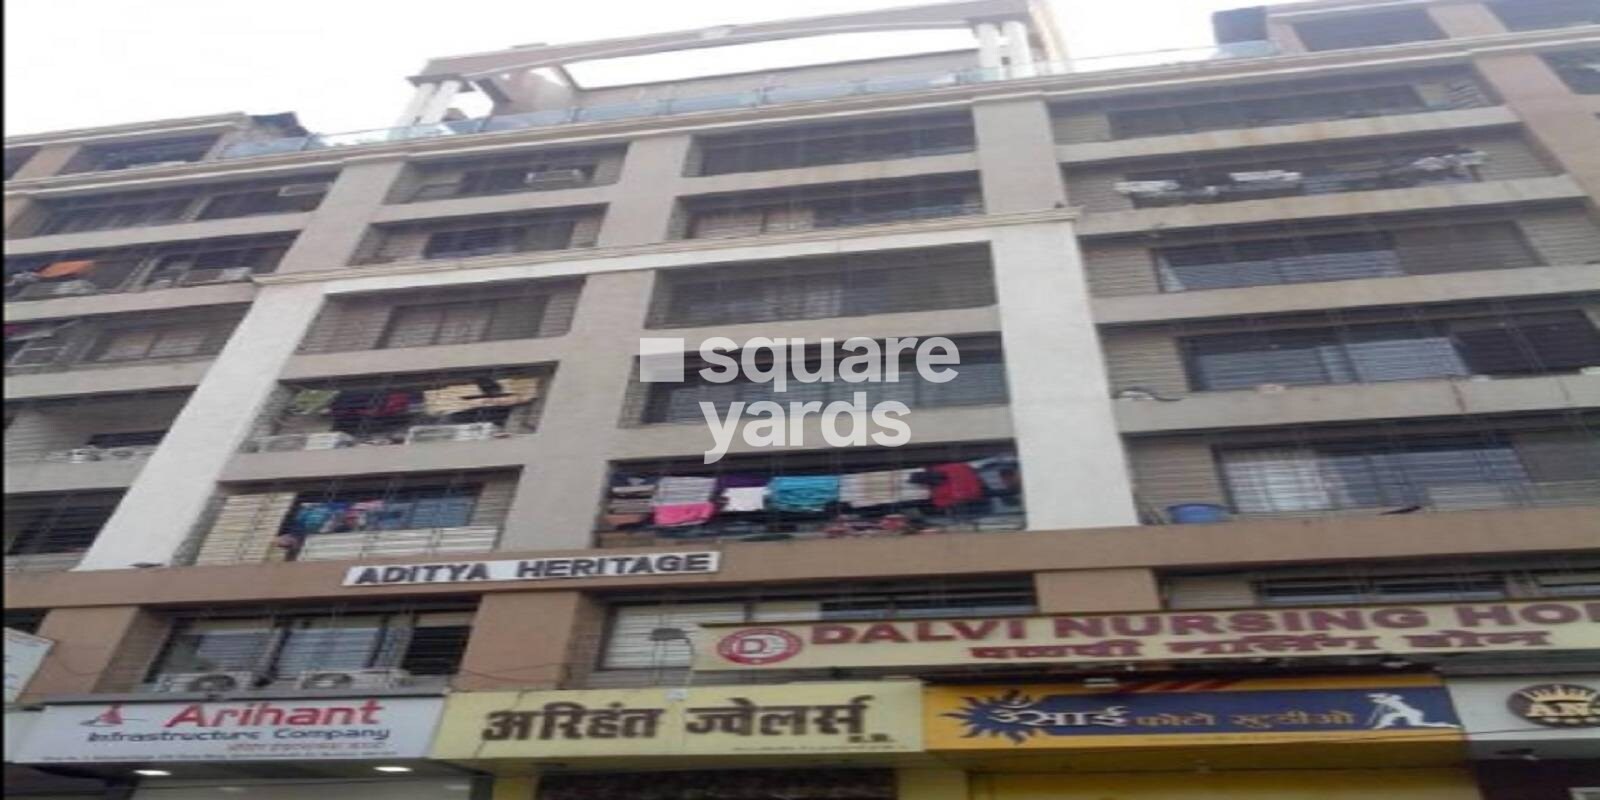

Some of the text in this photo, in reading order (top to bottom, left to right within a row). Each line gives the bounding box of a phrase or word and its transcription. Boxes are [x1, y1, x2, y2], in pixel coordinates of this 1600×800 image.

[355, 553, 710, 585] ADITYA HERITAGE
[811, 602, 1600, 645] DALVI NURSING HO
[164, 699, 384, 728] Arihant
[482, 701, 665, 742] अरिहंत
[86, 727, 391, 744] Infrastructure Company
